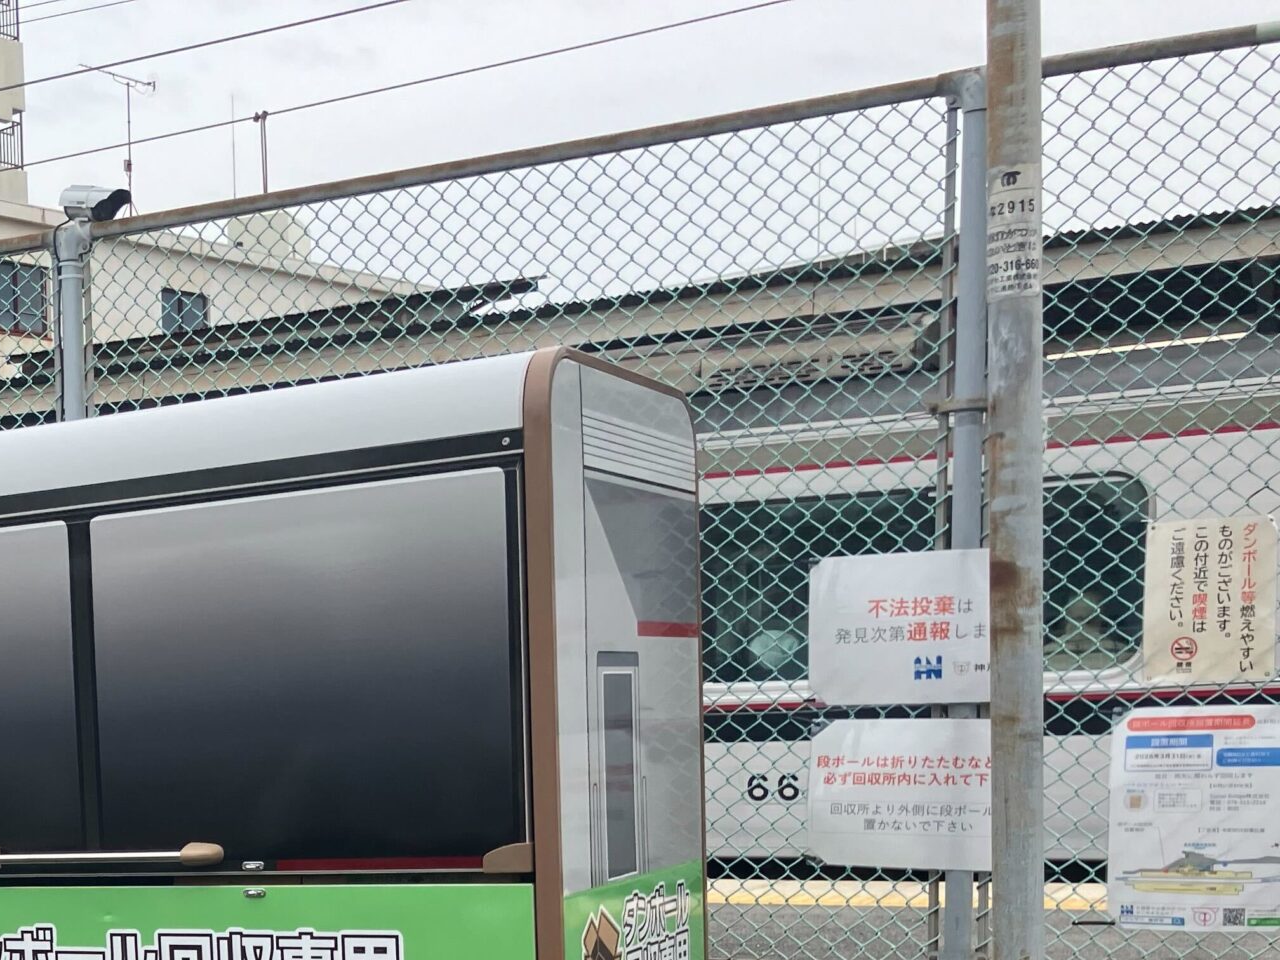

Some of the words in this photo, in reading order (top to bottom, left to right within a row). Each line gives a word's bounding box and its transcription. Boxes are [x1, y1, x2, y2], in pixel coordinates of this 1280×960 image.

[1169, 528, 1187, 628] ご遠慮ください。
[1192, 527, 1210, 634] この付近で喫煙は
[1216, 525, 1234, 639] ものがございます。
[868, 596, 973, 618] 不法投棄は
[835, 621, 988, 645] 発見次第通報しま
[747, 773, 800, 801] 66
[823, 771, 989, 787] 必ず回収所内に入れて下
[863, 818, 973, 832] 置かないで下さい
[623, 881, 690, 948] ダンボール
